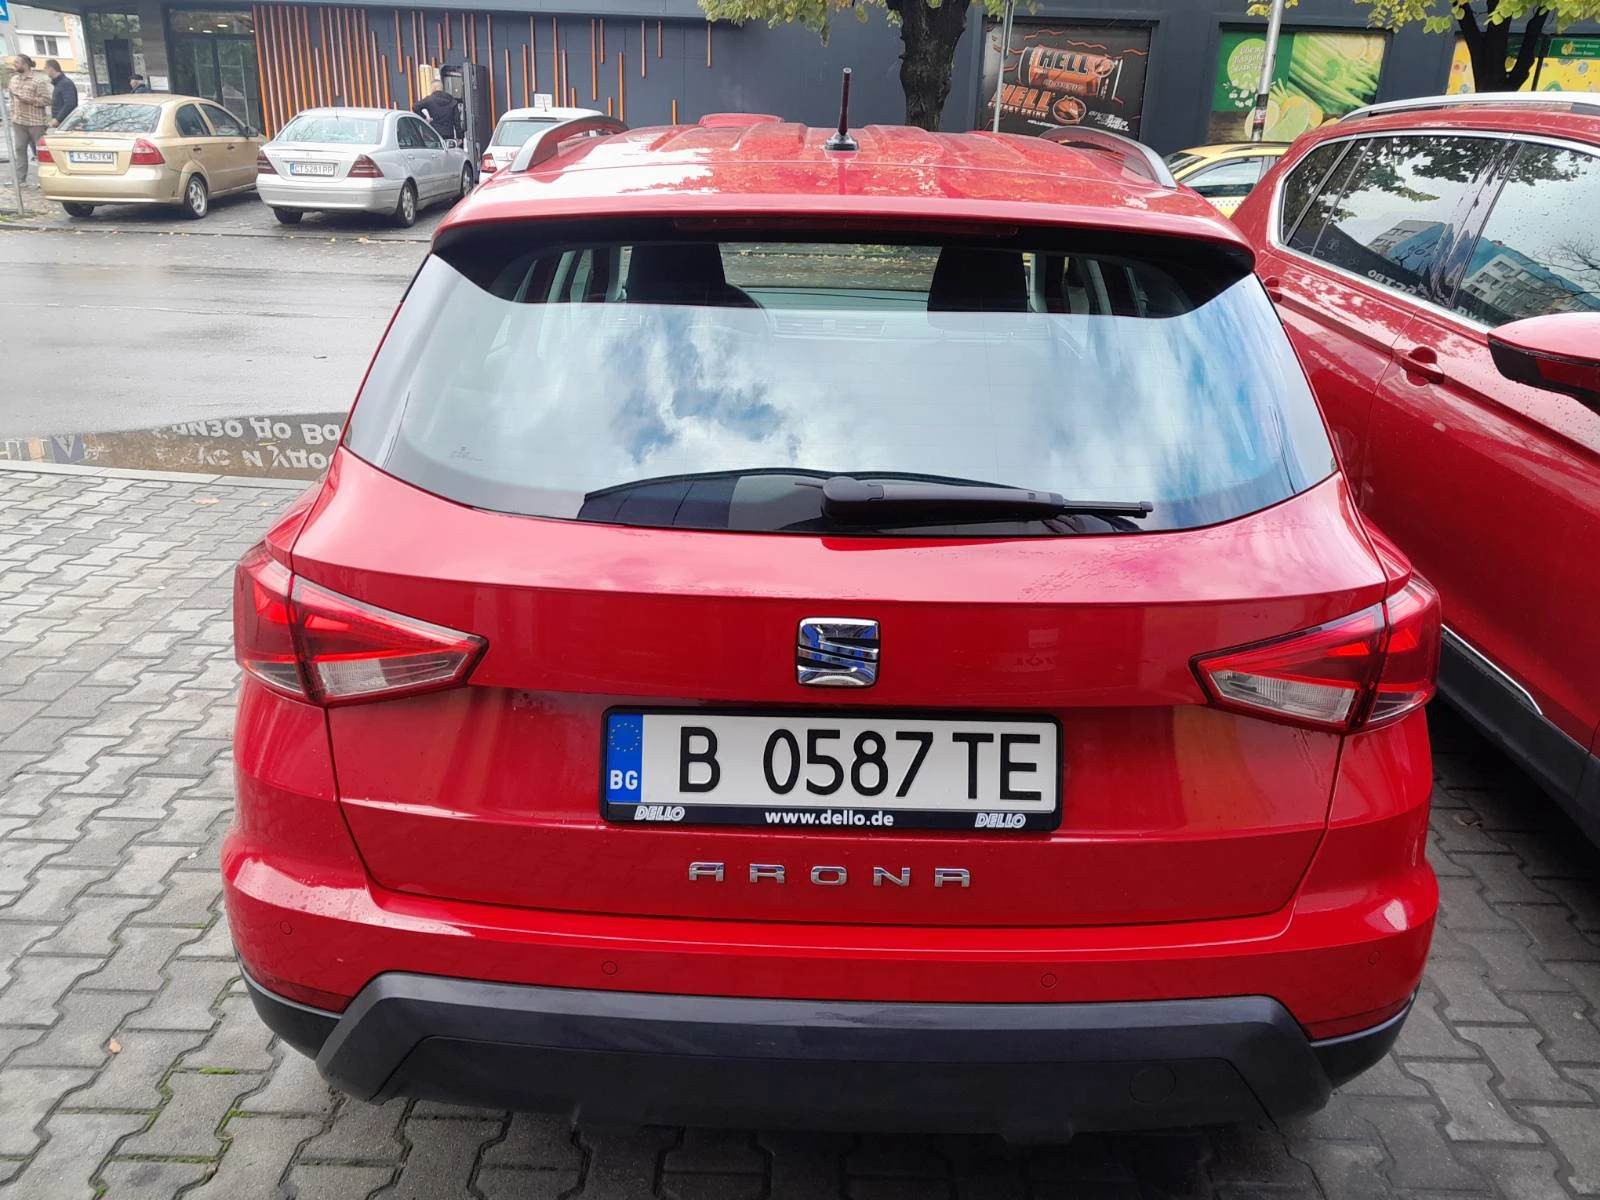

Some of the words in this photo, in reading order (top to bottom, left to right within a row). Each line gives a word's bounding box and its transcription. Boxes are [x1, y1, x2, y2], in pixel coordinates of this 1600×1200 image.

[1038, 48, 1089, 75] HELL
[679, 726, 721, 793] B
[763, 728, 934, 798] 0587
[952, 732, 1042, 801] TE
[609, 769, 639, 791] BG
[633, 805, 686, 822] DELLO
[765, 810, 894, 827] www.dello.de
[974, 812, 1027, 829] DELLO
[688, 861, 971, 888] ARONA
